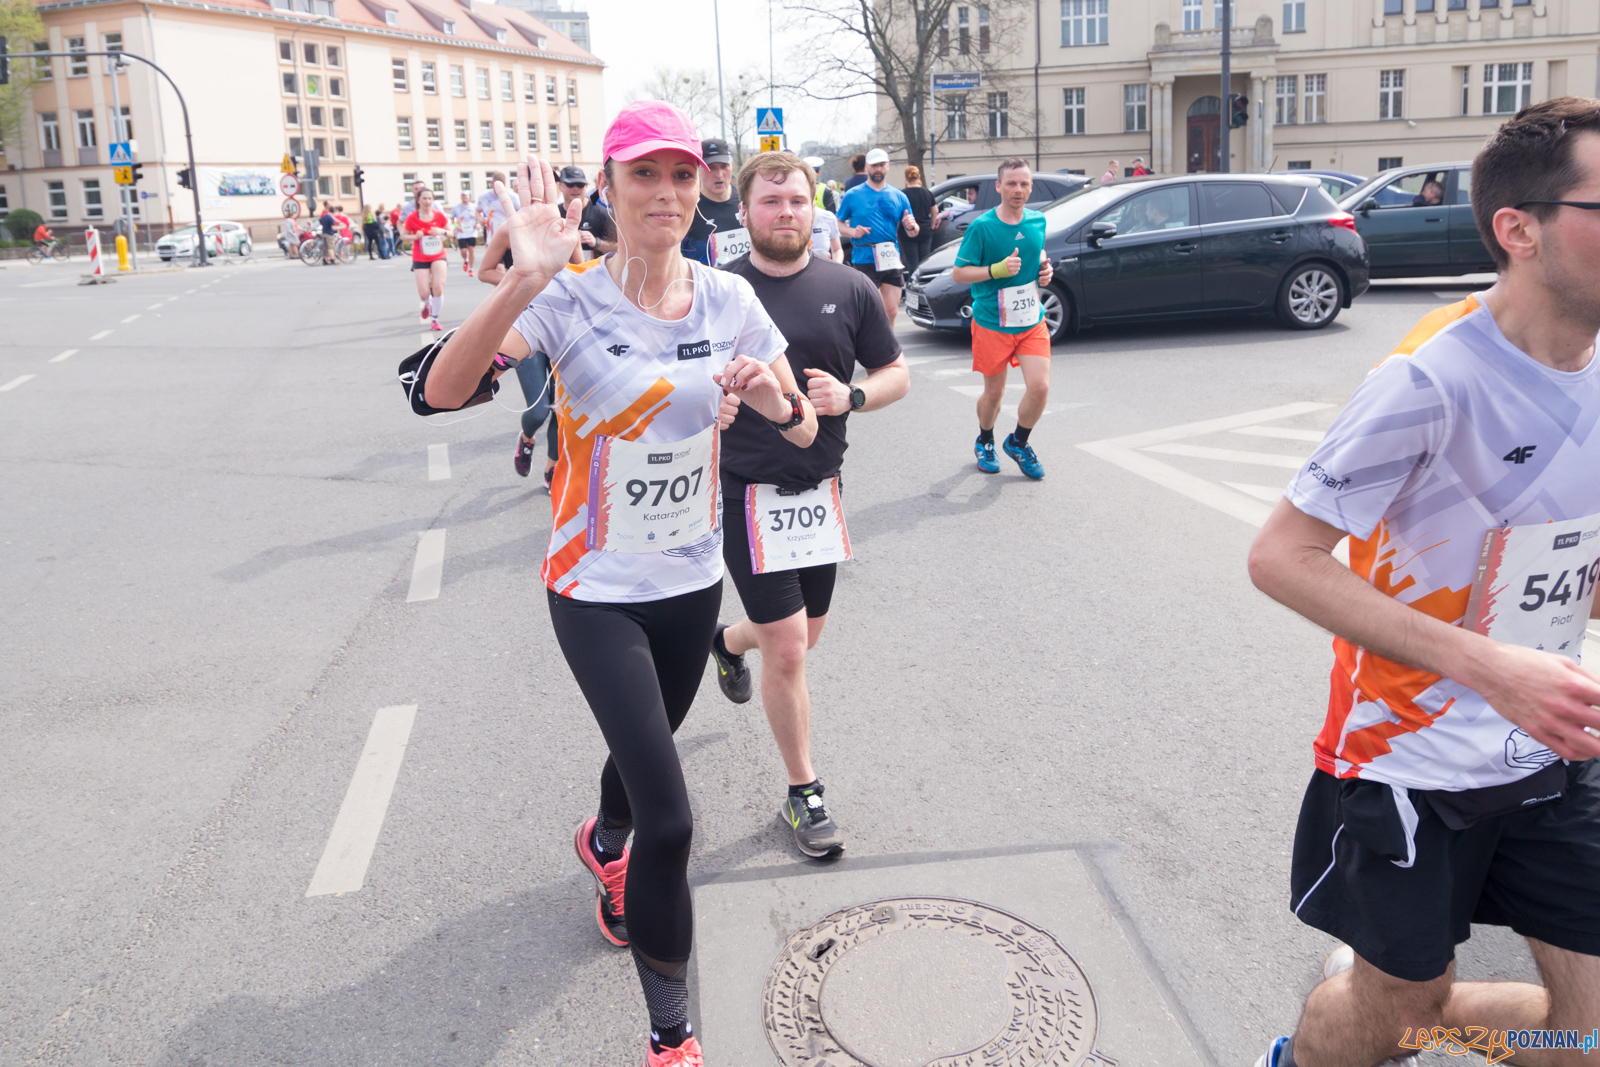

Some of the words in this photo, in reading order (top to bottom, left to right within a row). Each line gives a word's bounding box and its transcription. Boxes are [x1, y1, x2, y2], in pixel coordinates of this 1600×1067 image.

[285, 203, 298, 215] 40
[1012, 296, 1036, 311] 2316
[1503, 445, 1537, 464] 4F
[626, 466, 704, 507] 9707
[643, 507, 690, 524] Katarzyna
[768, 505, 827, 532] 3709
[787, 533, 816, 542] Krzysztof
[1519, 557, 1600, 612] 5419
[1550, 614, 1574, 627] Piotr
